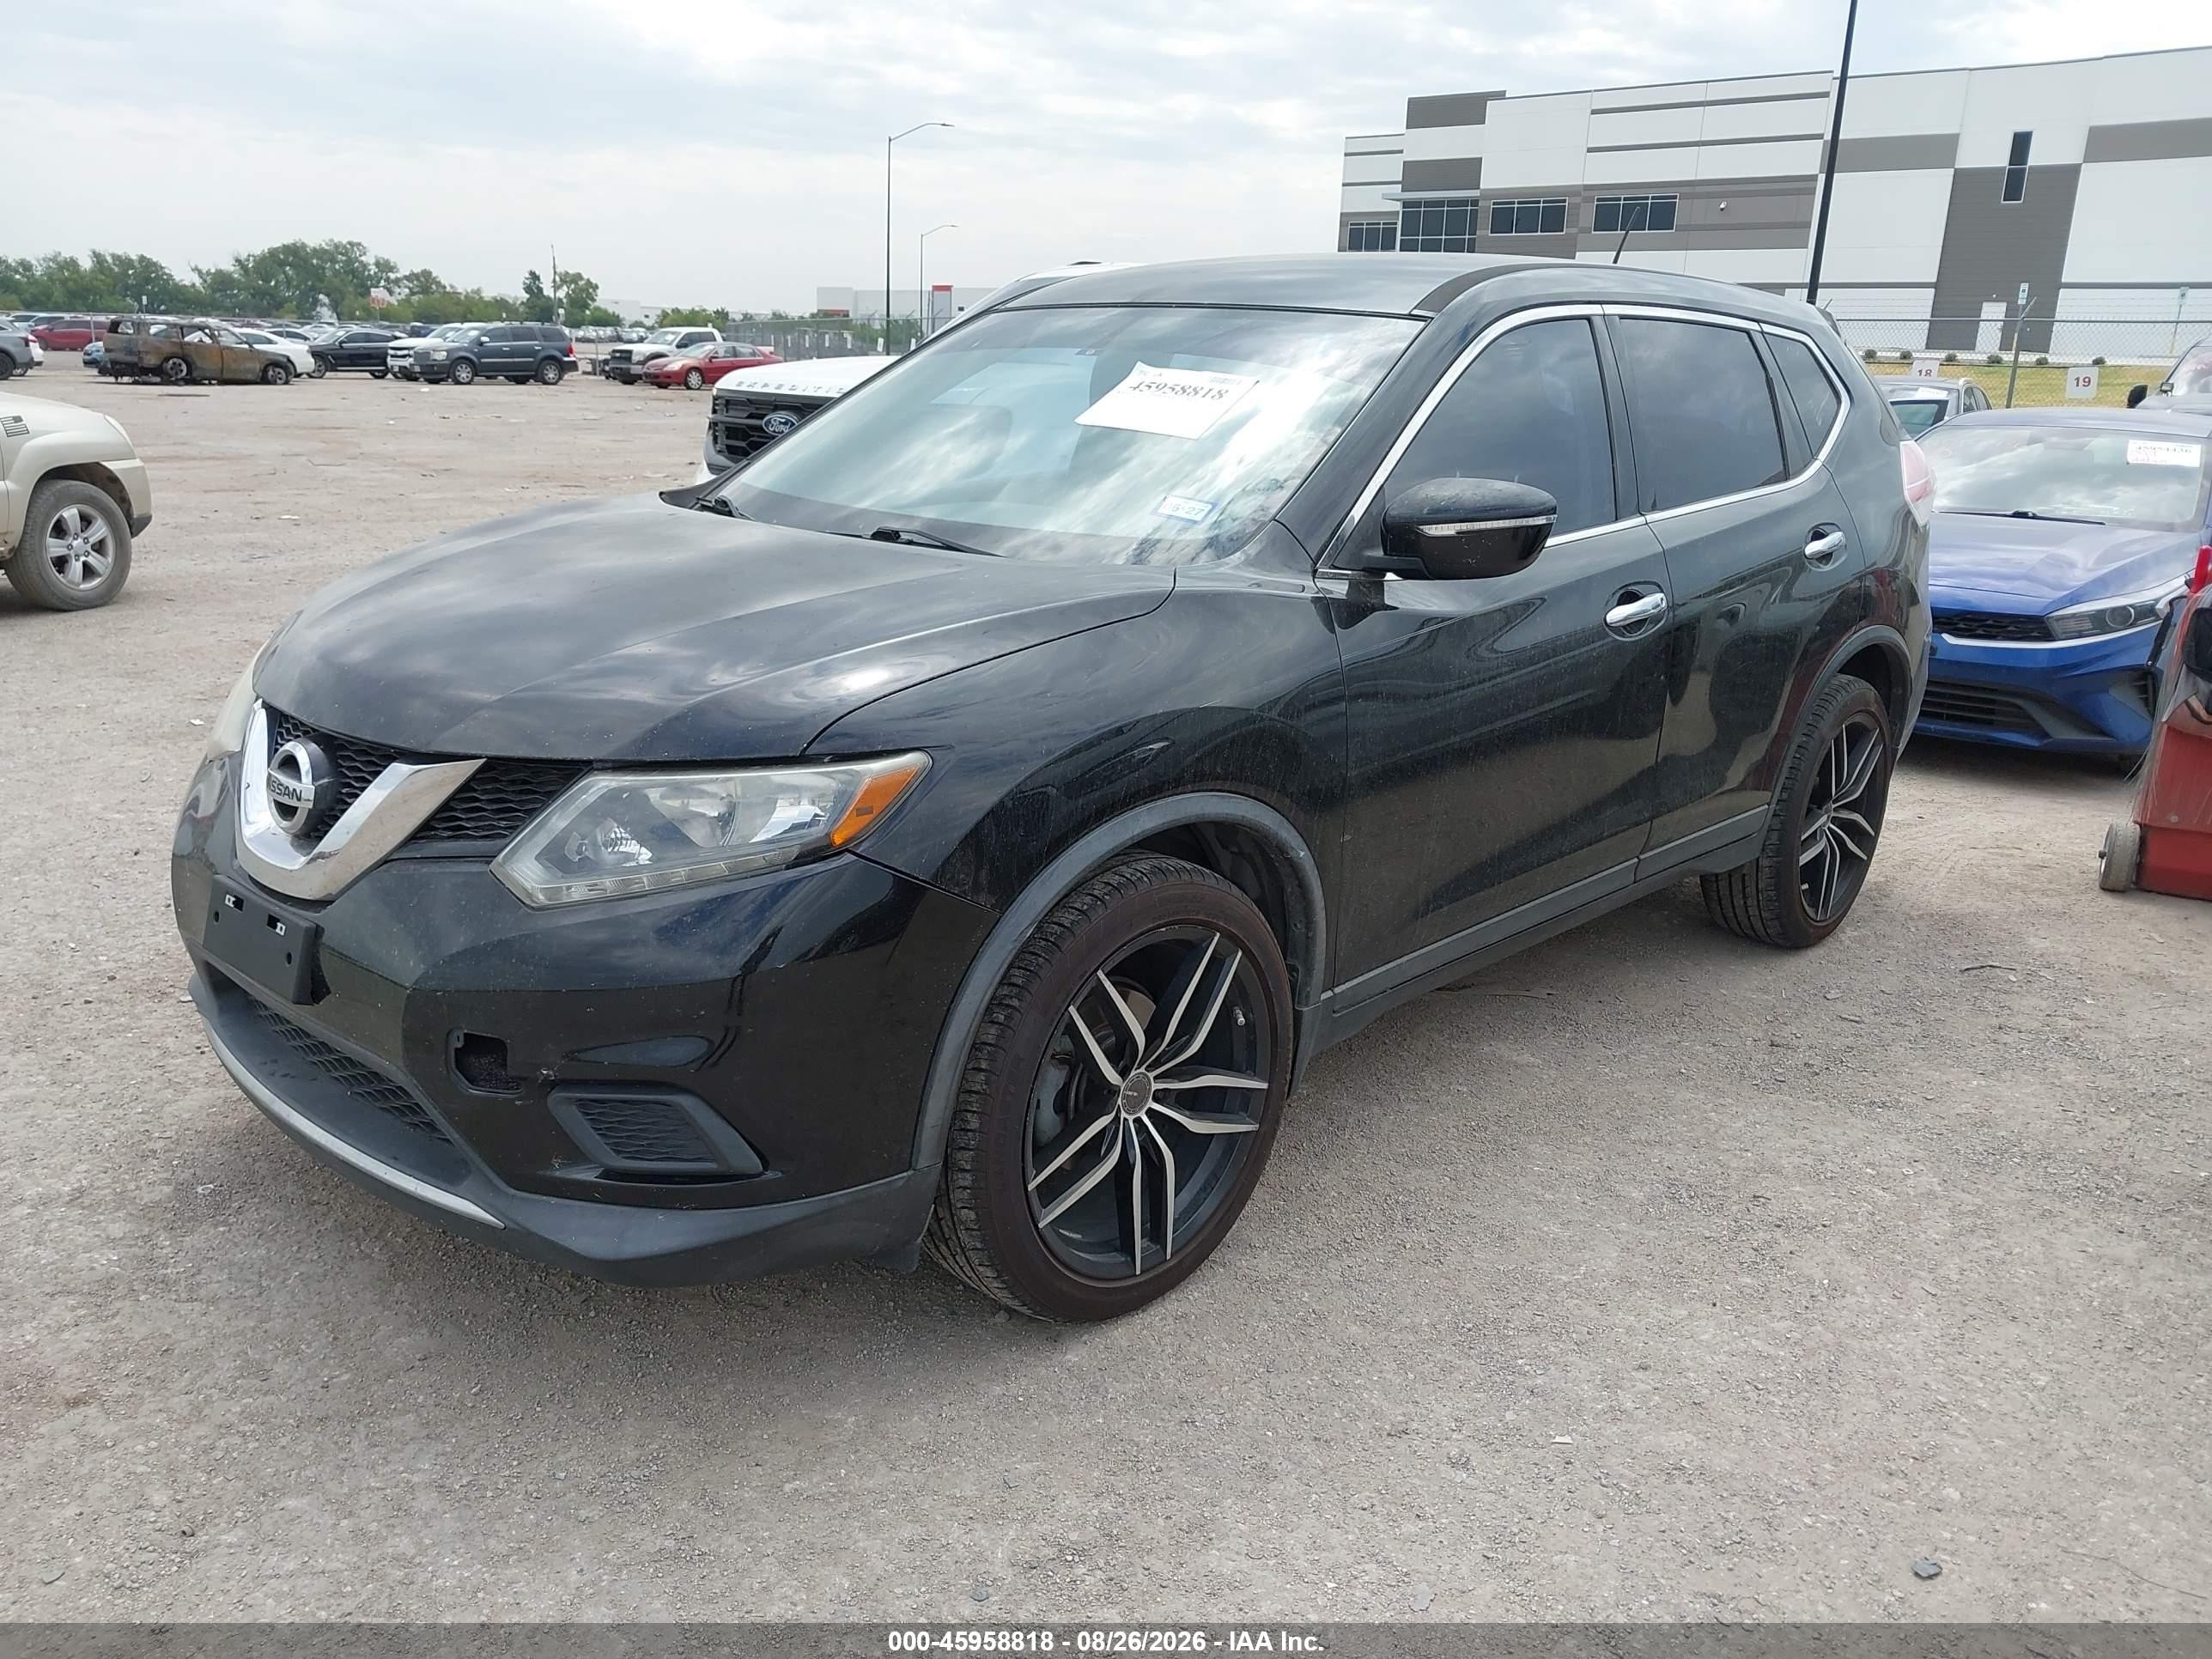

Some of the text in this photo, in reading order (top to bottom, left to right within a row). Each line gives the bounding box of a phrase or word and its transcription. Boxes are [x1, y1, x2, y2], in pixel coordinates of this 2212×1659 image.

[1917, 368, 1933, 378] 18
[2074, 375, 2092, 388] 19
[1128, 380, 1230, 400] 45958818
[768, 416, 791, 433] Ford
[1184, 506, 1206, 516] 27
